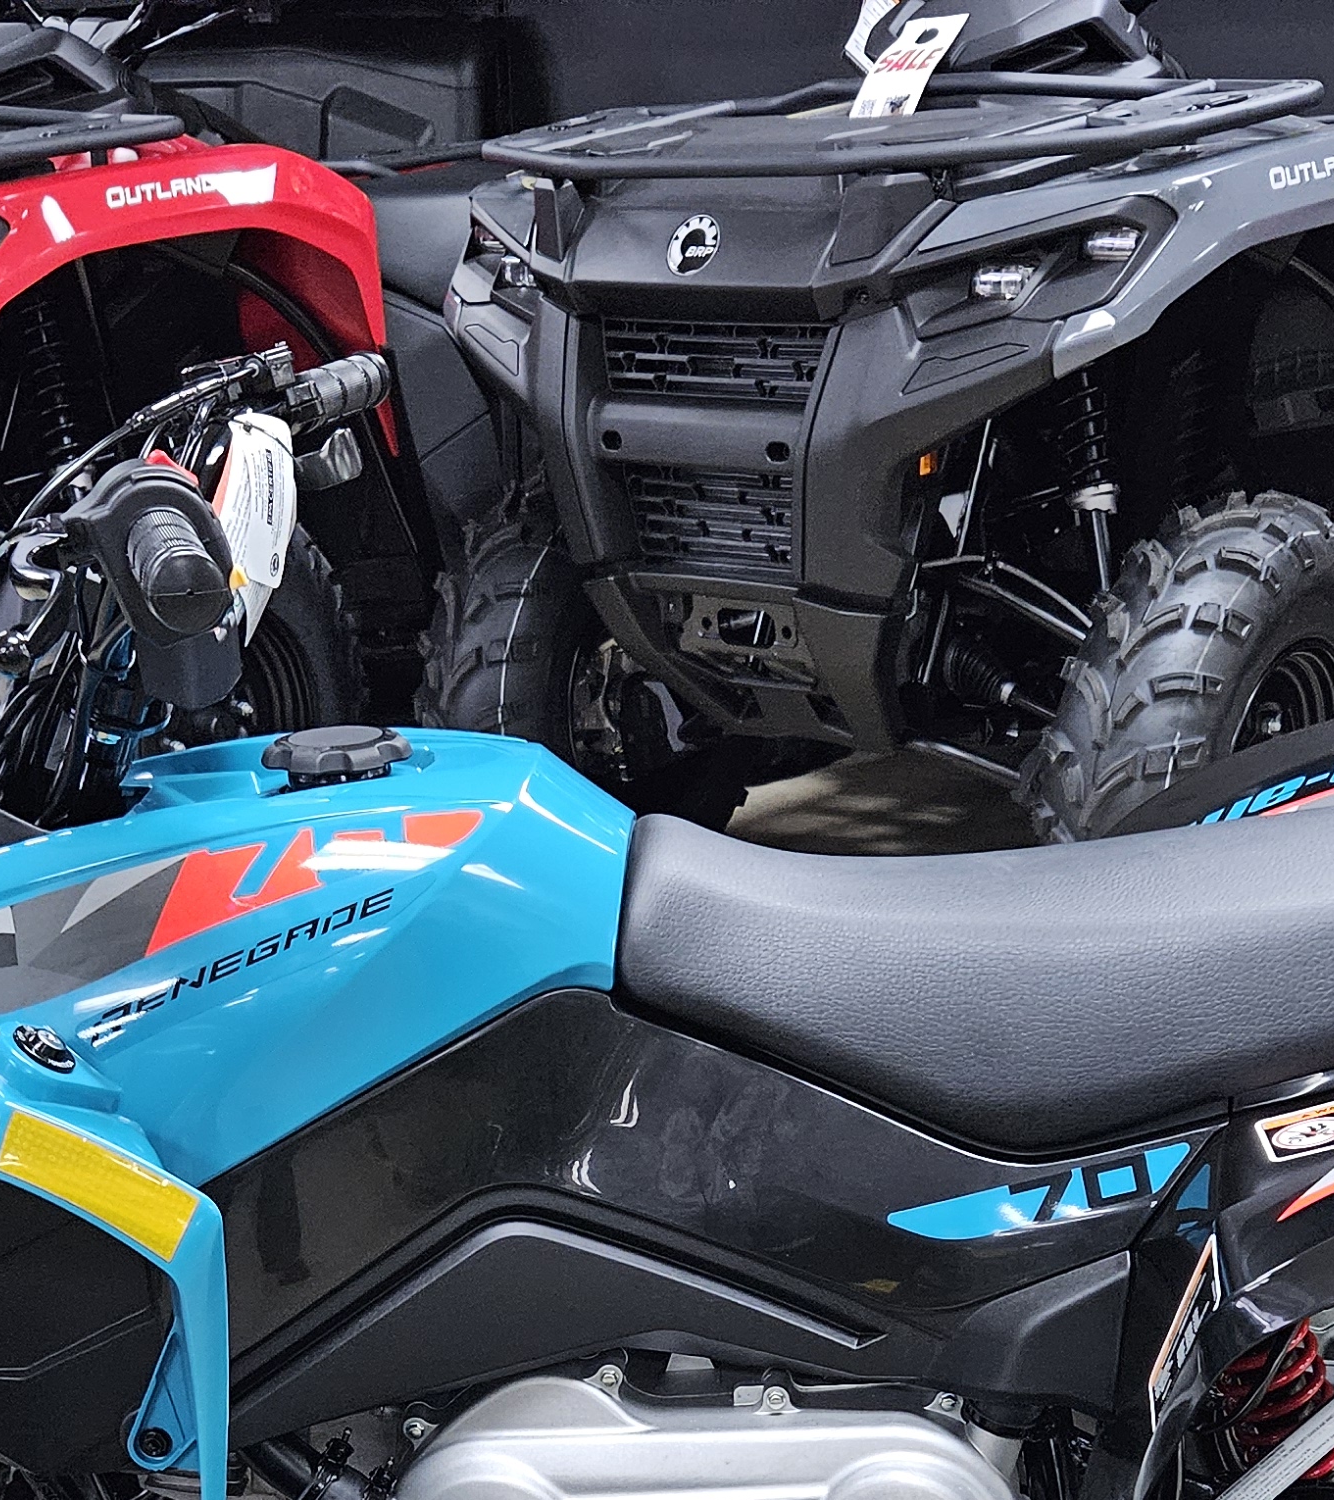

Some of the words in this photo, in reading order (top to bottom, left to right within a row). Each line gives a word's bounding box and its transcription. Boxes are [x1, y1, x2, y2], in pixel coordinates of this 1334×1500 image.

[873, 47, 944, 74] SALE
[105, 171, 233, 209] OUTLAND
[684, 245, 715, 258] BRP
[90, 888, 395, 1047] RENEGADE
[1008, 1152, 1154, 1222] 70
